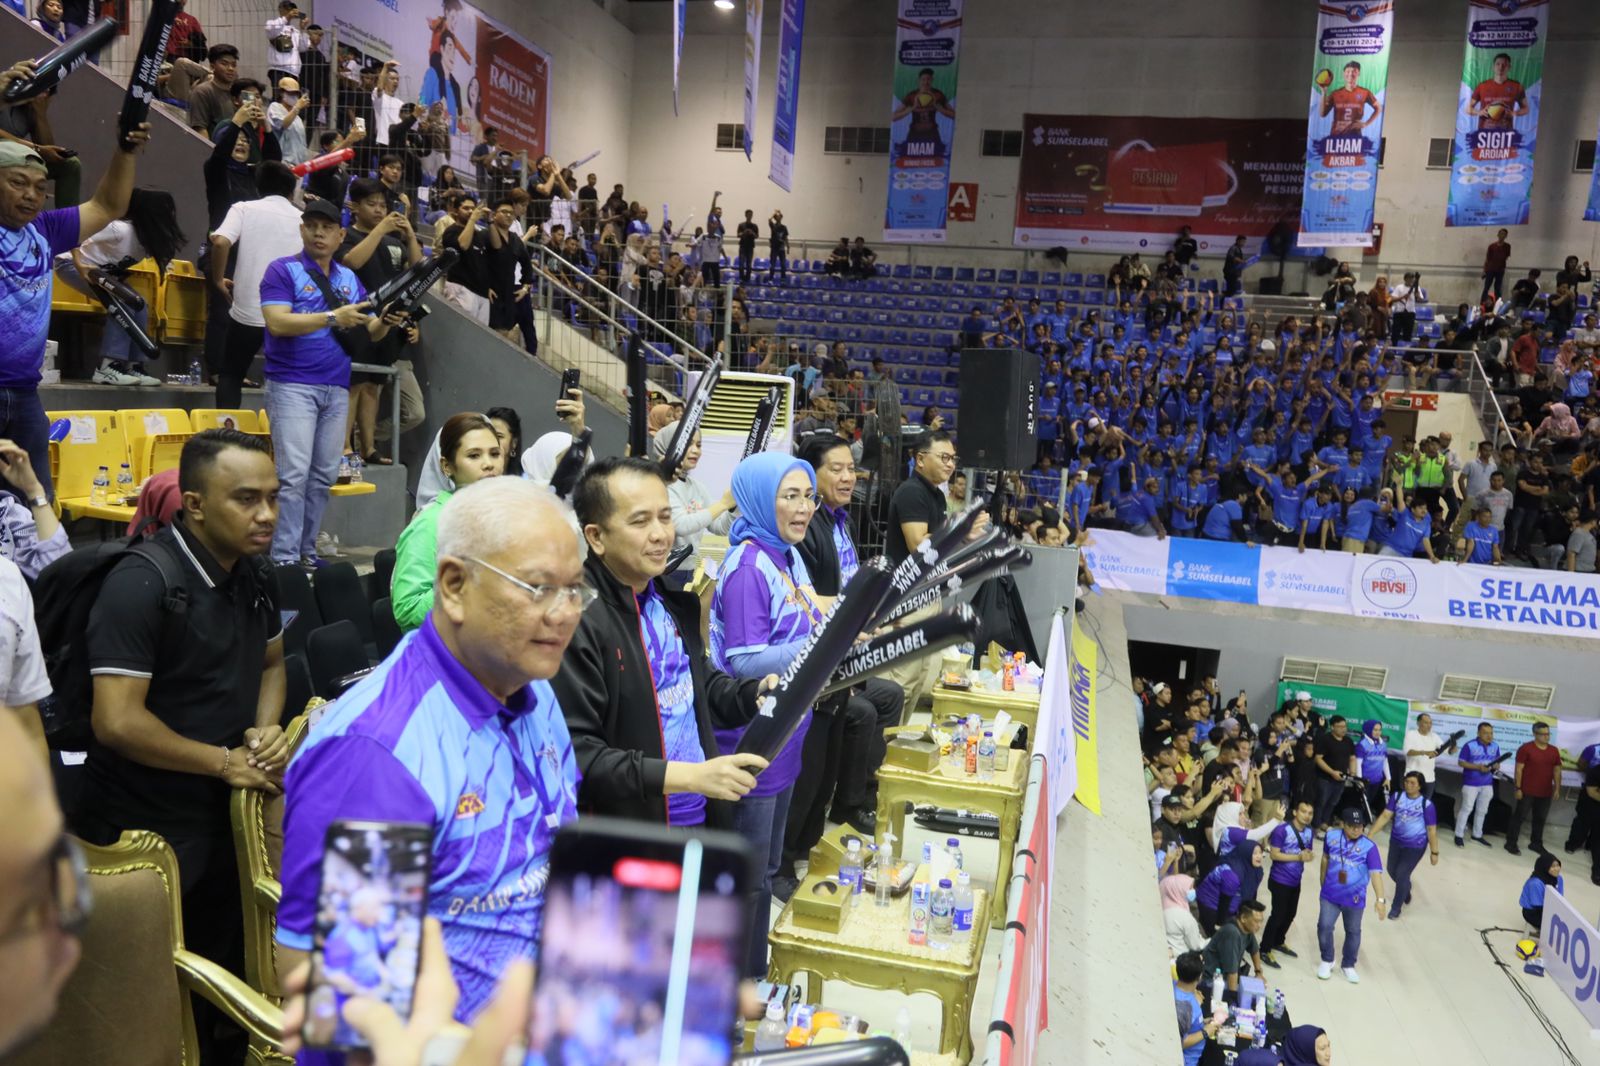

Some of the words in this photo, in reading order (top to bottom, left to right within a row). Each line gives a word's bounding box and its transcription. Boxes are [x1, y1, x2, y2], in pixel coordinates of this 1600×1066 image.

[138, 54, 152, 83] BANK
[489, 63, 537, 108] RADEN
[1047, 136, 1109, 147] SUMSELBABEL
[1325, 138, 1362, 154] ILHAM
[1477, 131, 1515, 149] SIGIT
[907, 142, 935, 156] IMAM
[1479, 148, 1510, 160] ARDIAN
[1328, 156, 1356, 167] AKBAR
[949, 185, 971, 209] A
[1099, 553, 1122, 564] BANK
[1099, 562, 1161, 577] SUMSELBABEL
[1187, 562, 1213, 573] BANK
[1187, 571, 1253, 587] SUMSELBABEL
[1279, 572, 1304, 582] BANK
[1279, 581, 1346, 596] SUMSELBABEL
[1371, 580, 1406, 594] PBVSI
[1479, 578, 1600, 609] SELAMA
[1448, 599, 1599, 630] BERTANDI
[838, 628, 929, 682] SUMSELBABEL
[973, 829, 996, 838] BANK
[448, 885, 513, 917] BANK
